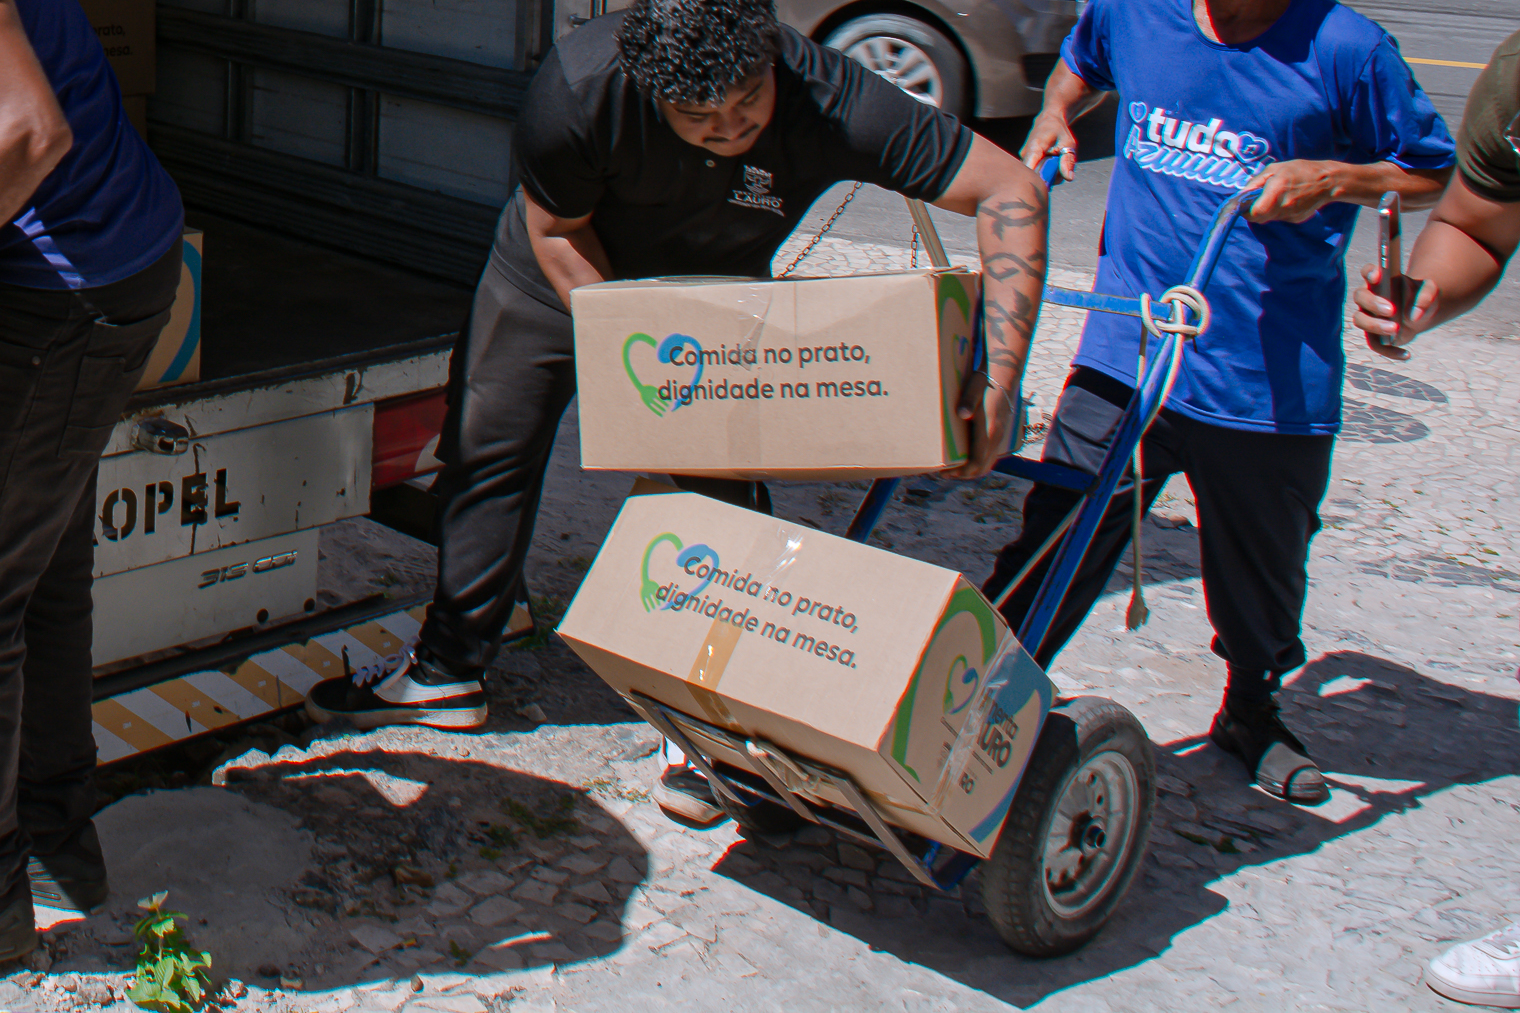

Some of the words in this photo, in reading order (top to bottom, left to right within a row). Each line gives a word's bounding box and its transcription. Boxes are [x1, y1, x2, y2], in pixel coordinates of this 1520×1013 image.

[1147, 107, 1240, 158] tudo
[734, 192, 781, 208] LAURO
[669, 343, 757, 366] Comida
[764, 347, 792, 364] no
[799, 341, 871, 369] prato,
[658, 378, 774, 406] dignidade
[780, 381, 810, 399] na
[816, 380, 889, 398] mesa.
[92, 468, 241, 547] OPEL
[684, 556, 763, 597] Comida
[763, 586, 792, 608] no
[791, 596, 859, 634] prato,
[656, 581, 759, 632] dignidade
[760, 620, 792, 643] na
[792, 632, 857, 669] mesa.
